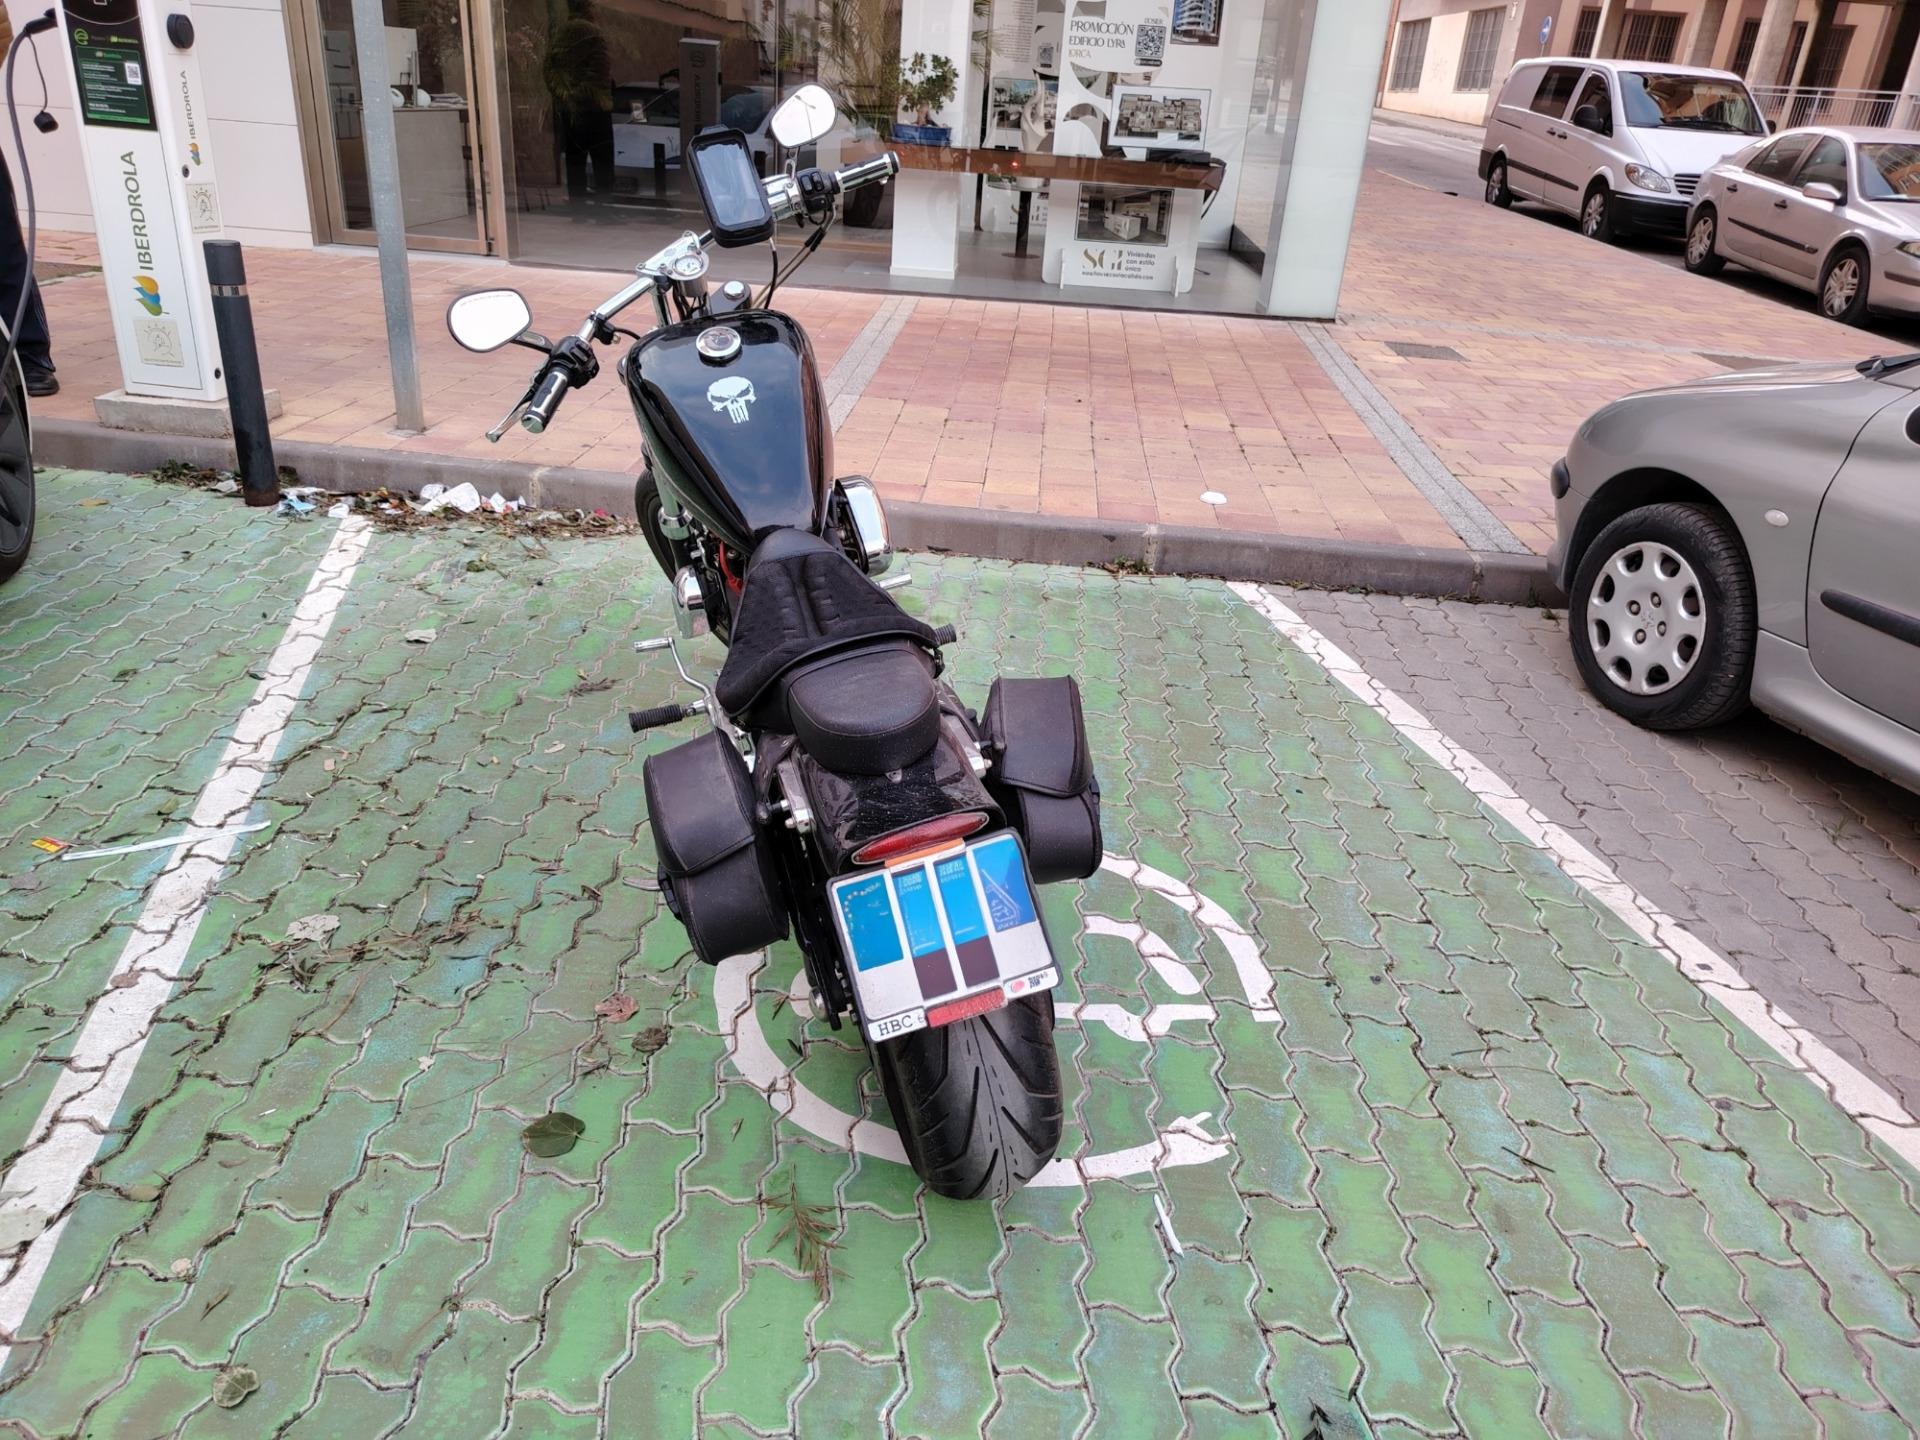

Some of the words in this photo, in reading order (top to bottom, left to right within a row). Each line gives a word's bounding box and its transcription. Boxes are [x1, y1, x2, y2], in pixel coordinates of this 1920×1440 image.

[1070, 20, 1135, 36] PROMOCIÓN
[1069, 35, 1105, 48] EDIFICIO
[180, 70, 196, 140] IBERDROLA
[120, 150, 154, 271] IBERDROLA
[878, 1014, 914, 1037] HBC
